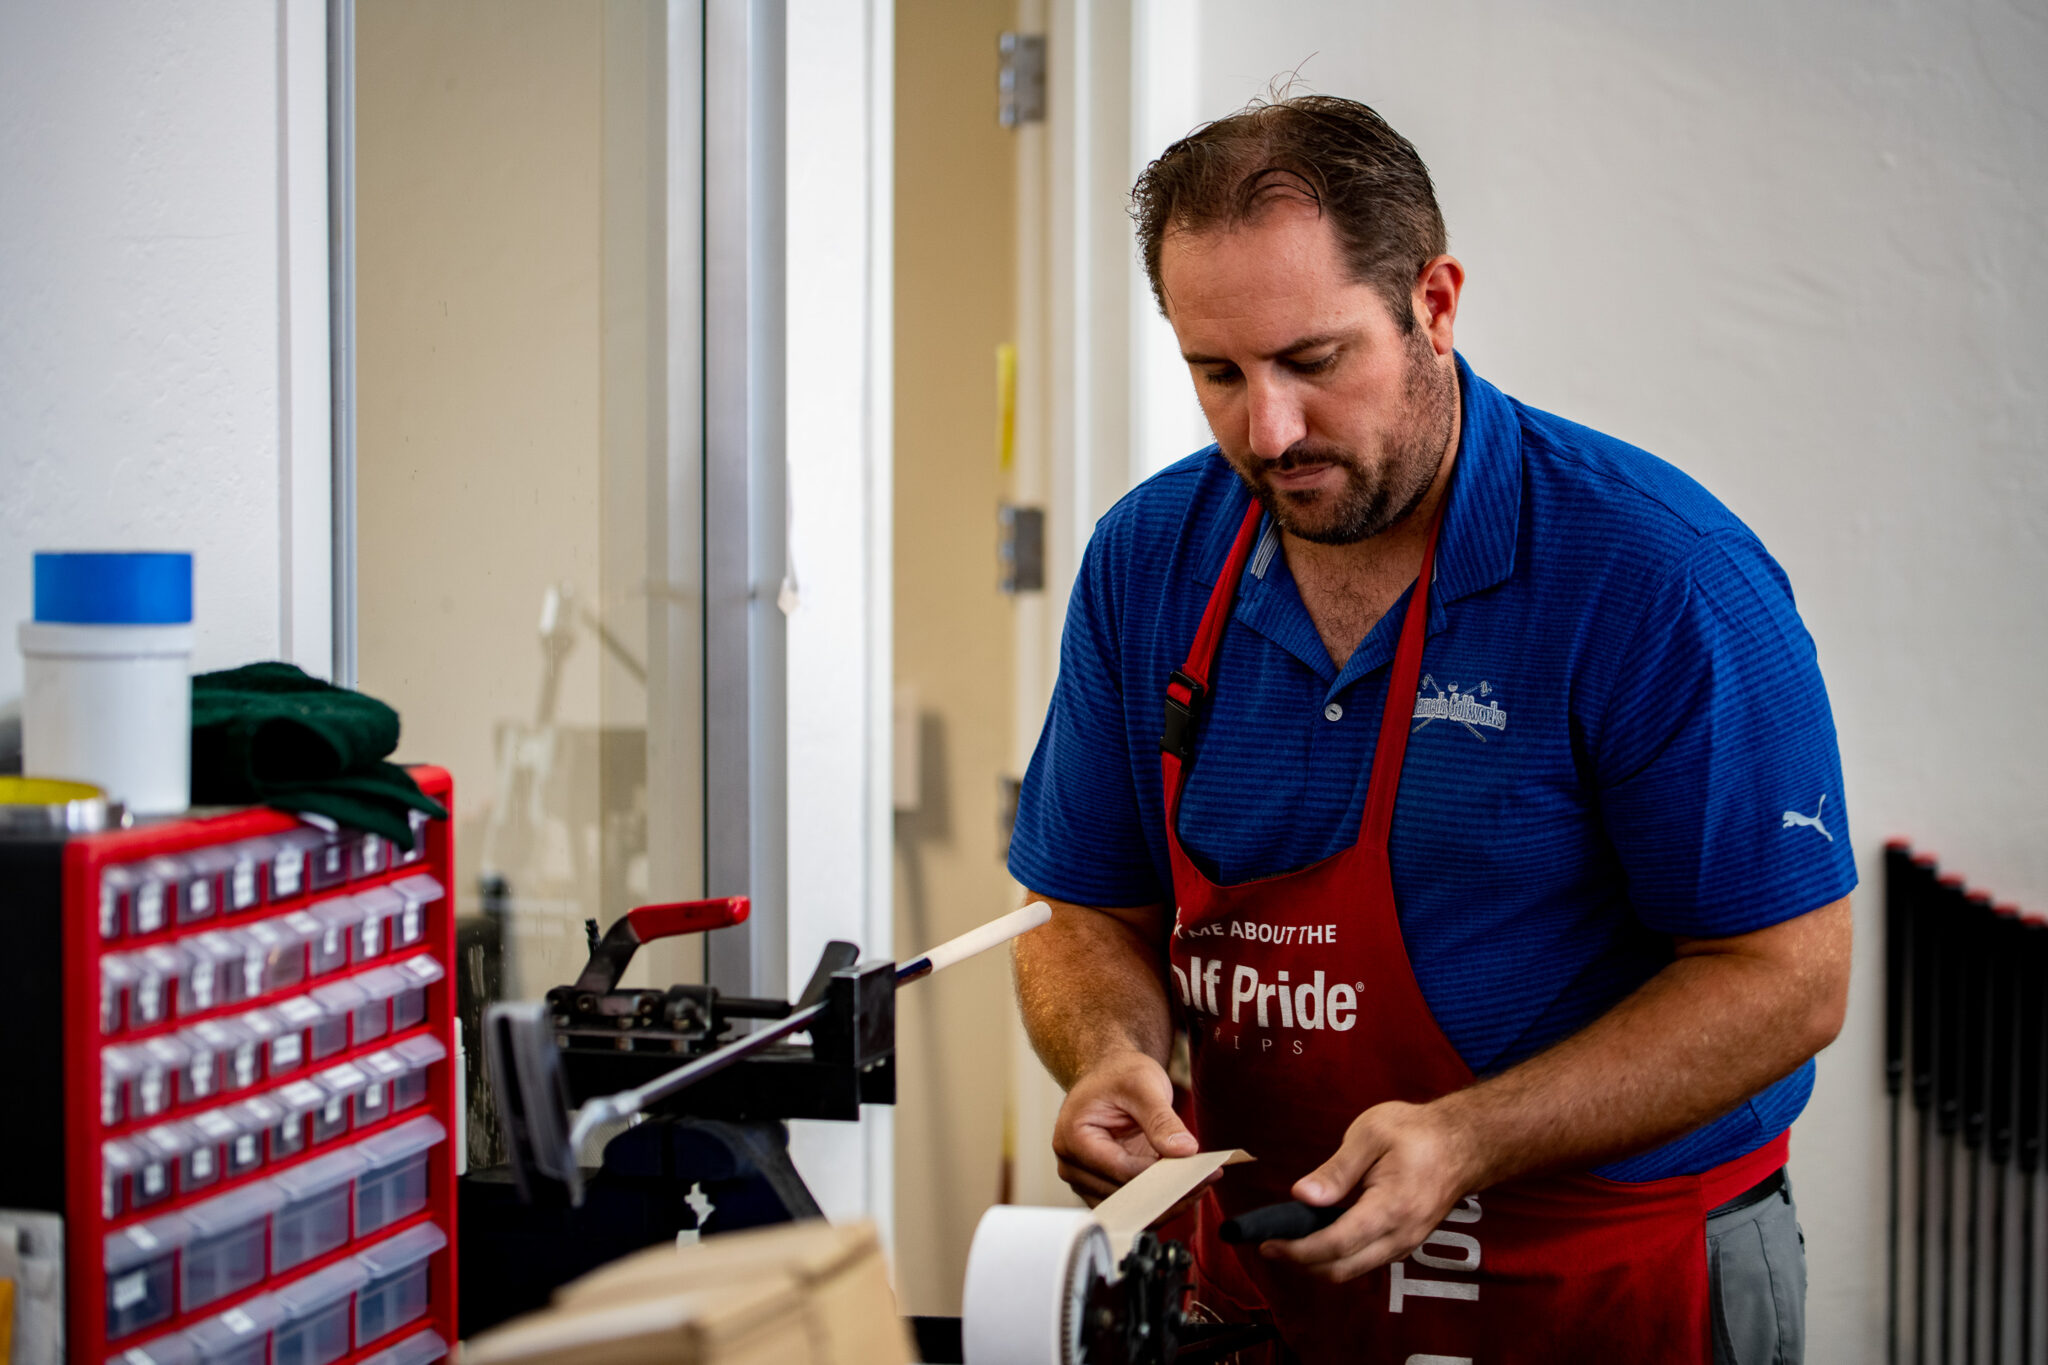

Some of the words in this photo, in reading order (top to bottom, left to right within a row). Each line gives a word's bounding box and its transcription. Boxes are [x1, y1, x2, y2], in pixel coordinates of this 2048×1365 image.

[1188, 923, 1223, 938] ME
[1230, 921, 1296, 945] ABOUT
[1297, 925, 1337, 944] THE
